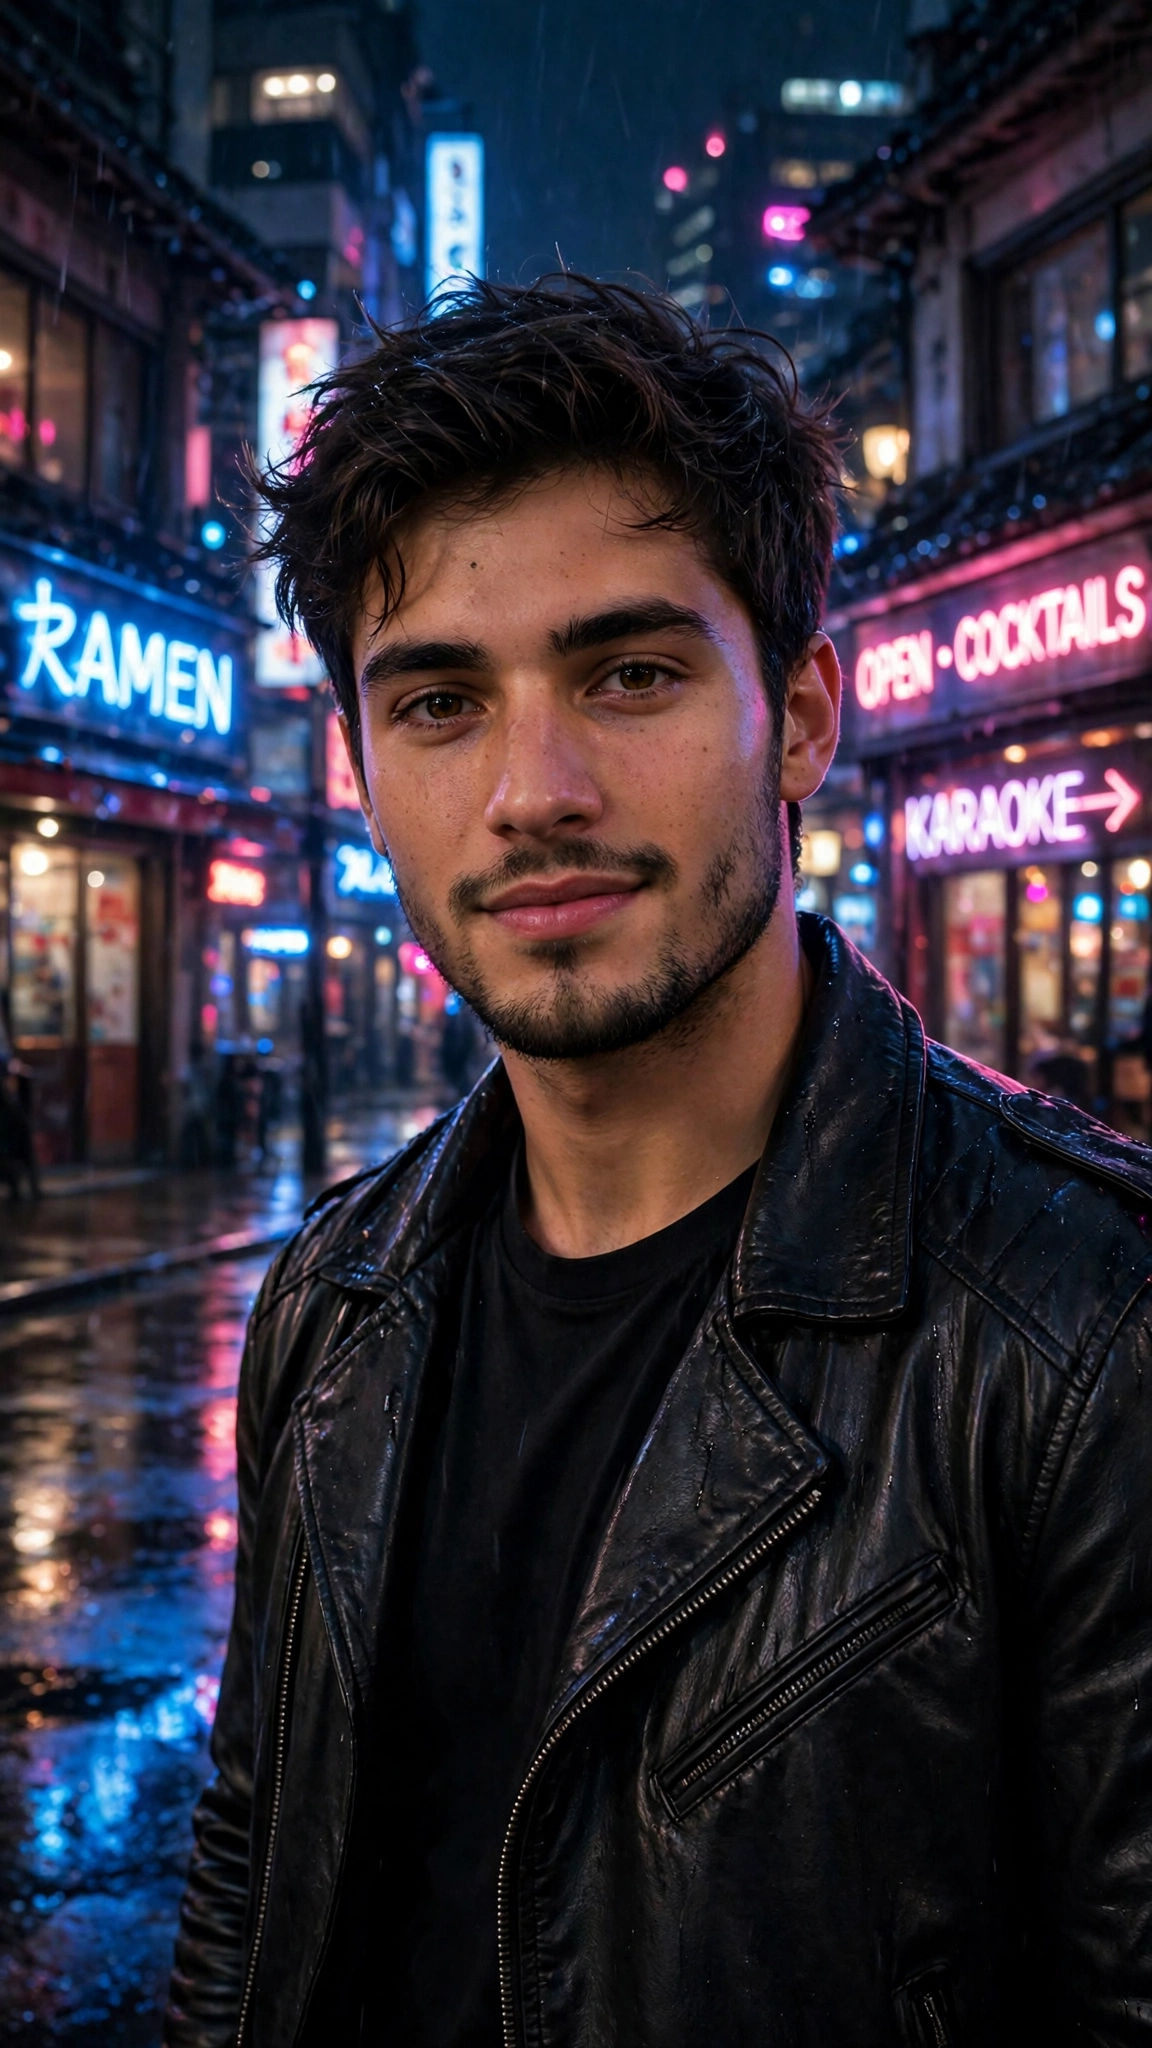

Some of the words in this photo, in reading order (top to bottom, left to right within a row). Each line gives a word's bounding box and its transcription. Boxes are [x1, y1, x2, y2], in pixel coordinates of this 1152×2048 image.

[16, 577, 233, 735] RAMEN
[855, 630, 934, 710] OPEN
[954, 565, 1147, 682] COCKTAILS
[905, 770, 1085, 861] KARAOKE
